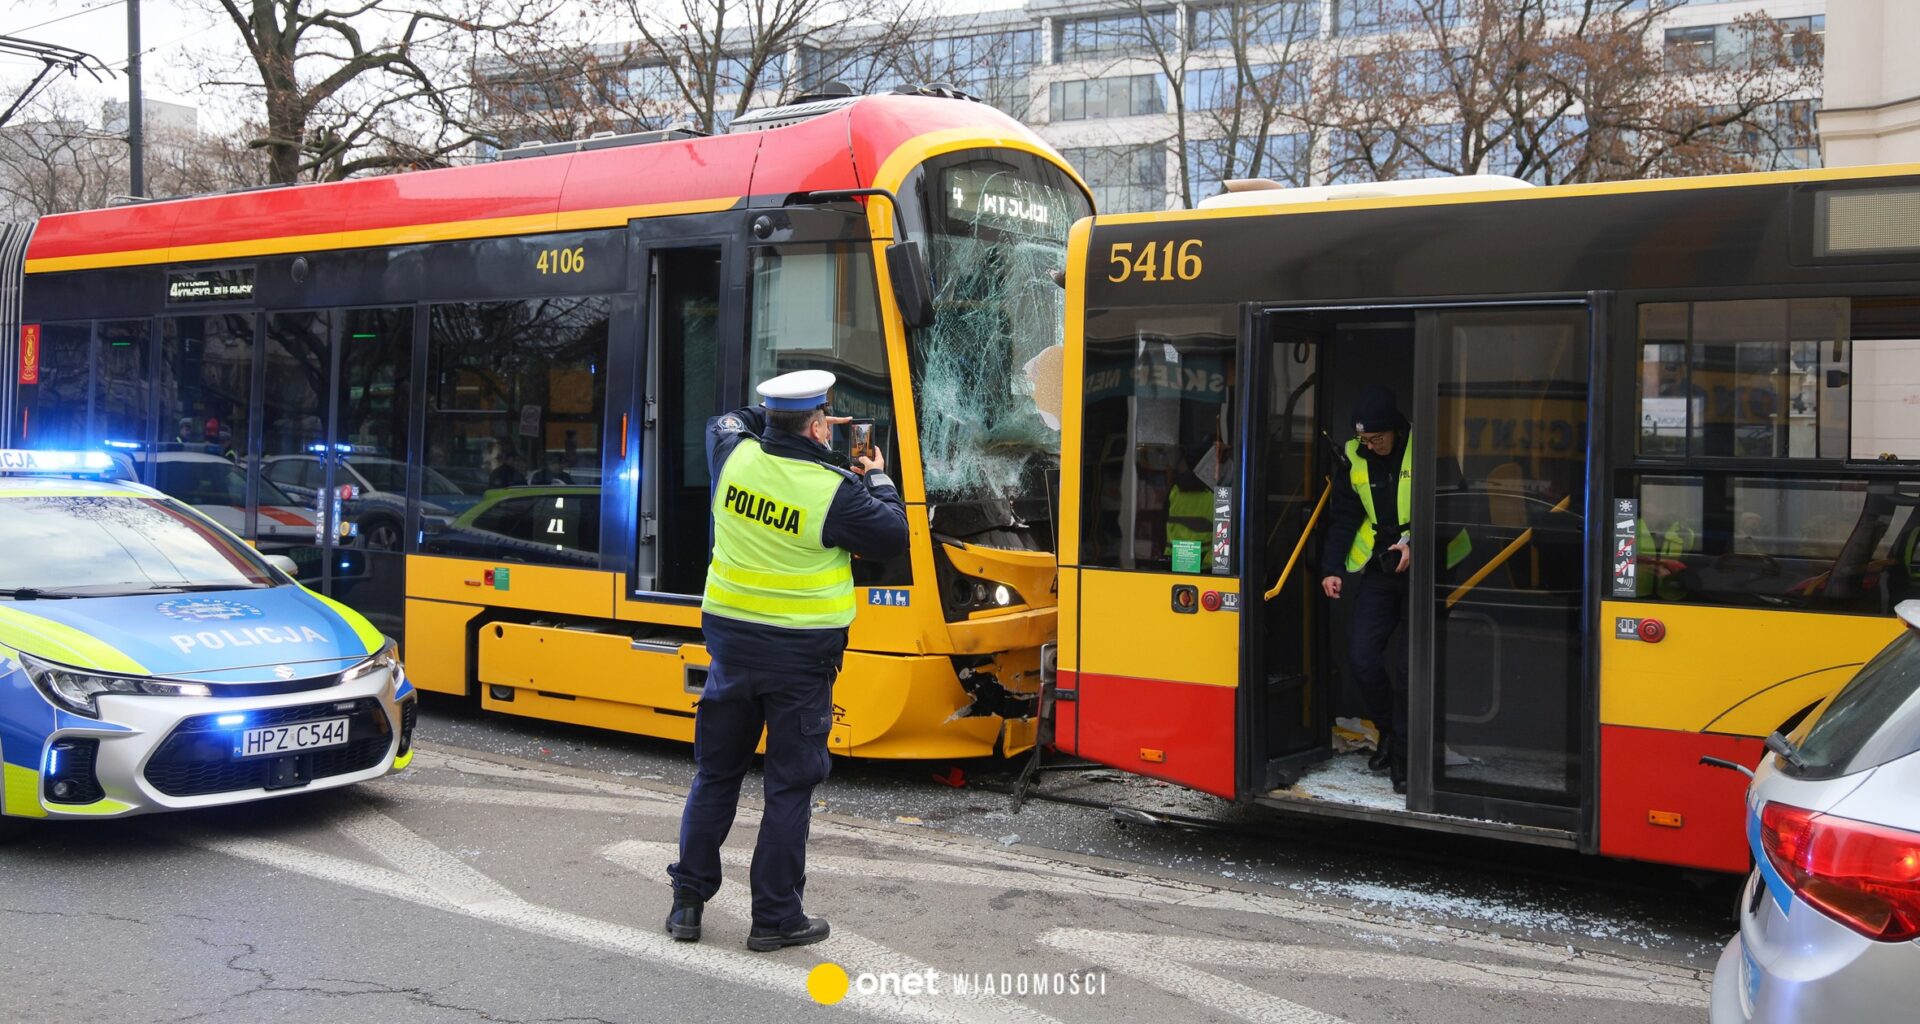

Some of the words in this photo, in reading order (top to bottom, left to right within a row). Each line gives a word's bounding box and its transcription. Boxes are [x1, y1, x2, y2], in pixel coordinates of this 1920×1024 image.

[953, 187, 964, 208] 4
[536, 247, 585, 274] 4106
[1108, 239, 1202, 283] 5416
[725, 485, 800, 535] POLICJA
[169, 626, 328, 654] POLICJA
[247, 728, 288, 753] HPZ
[297, 721, 344, 747] C544
